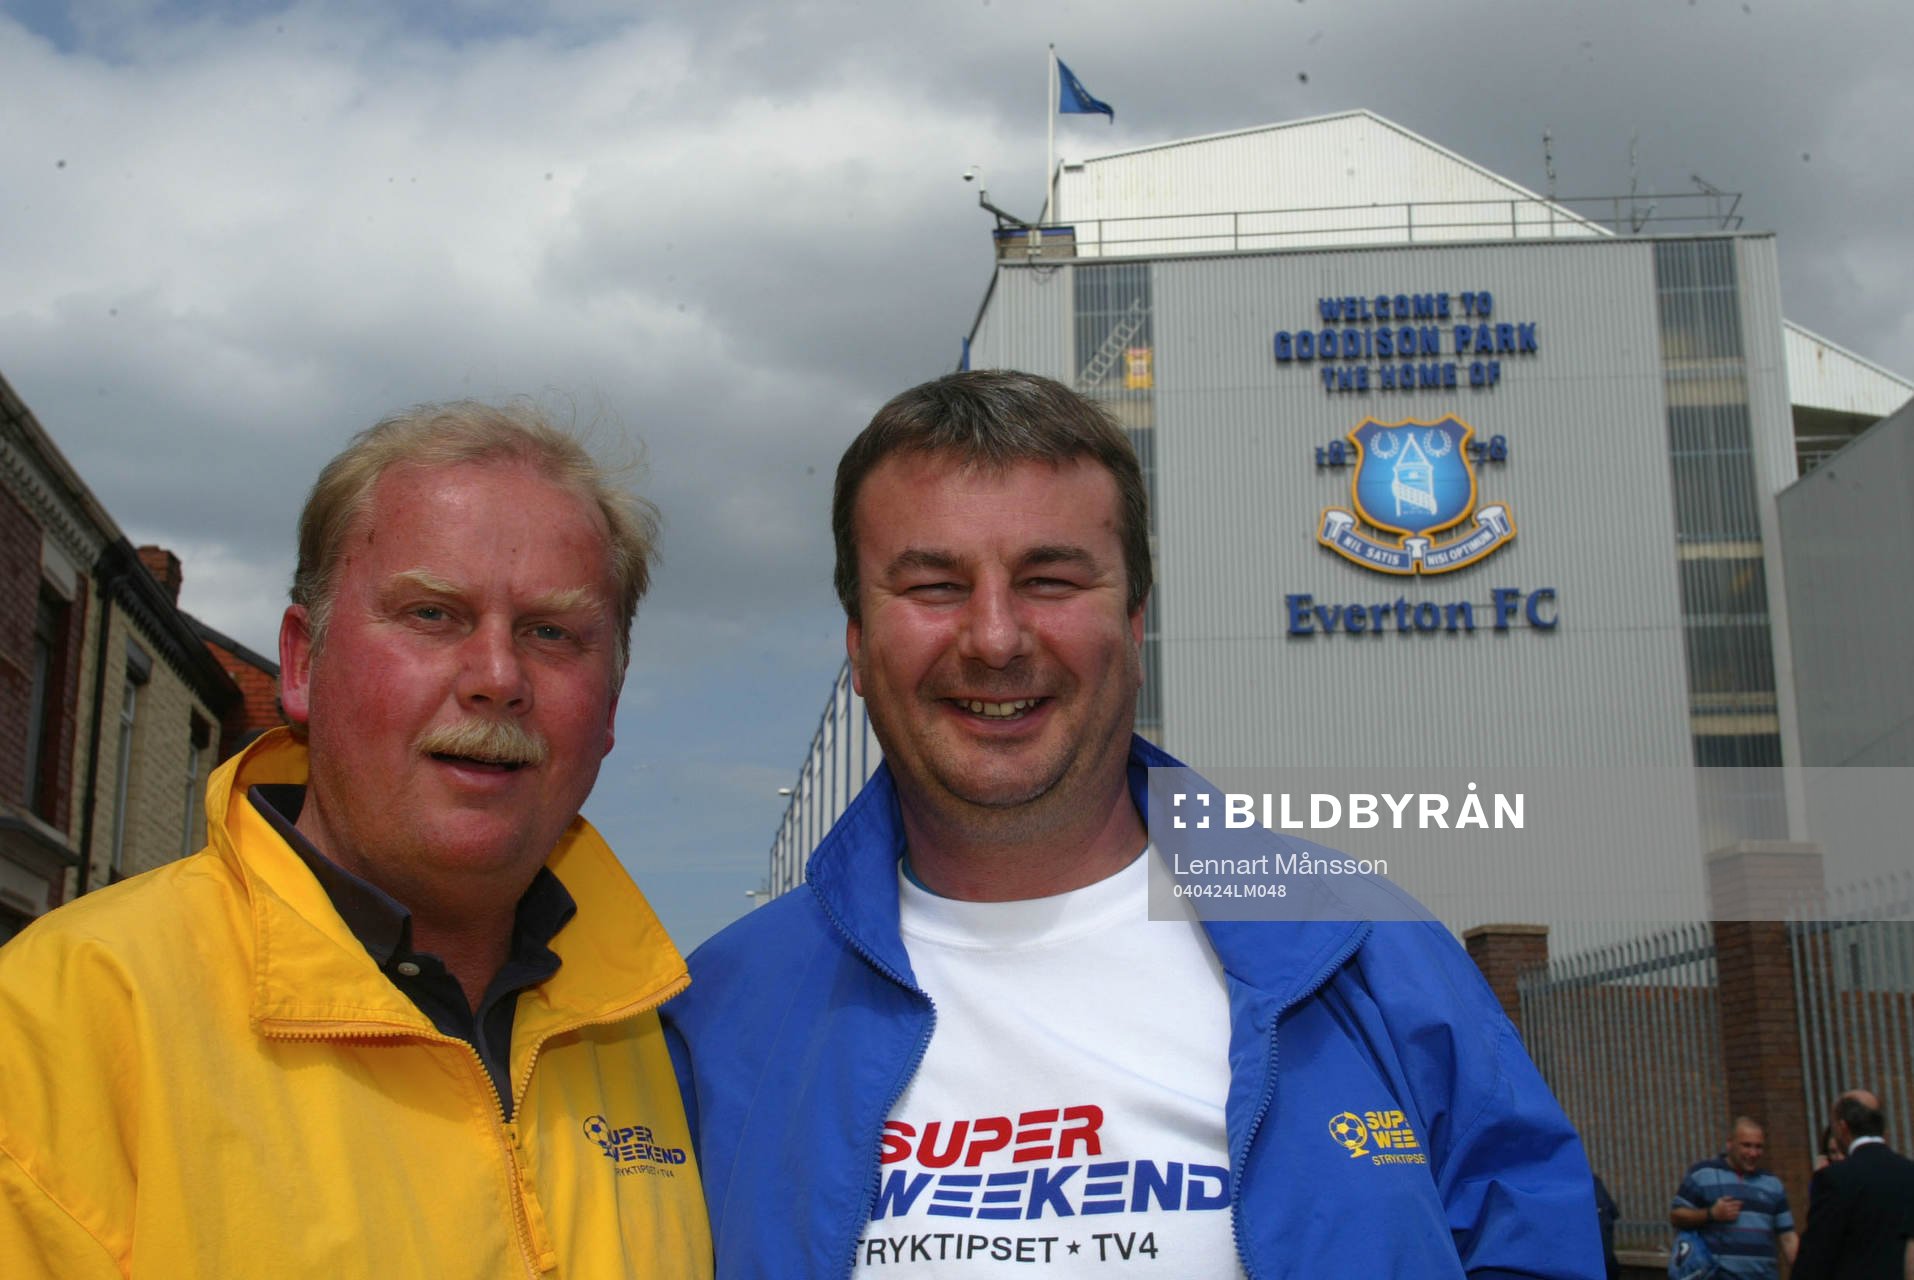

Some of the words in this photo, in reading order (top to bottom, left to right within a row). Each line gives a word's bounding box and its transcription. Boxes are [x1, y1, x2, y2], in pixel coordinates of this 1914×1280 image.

[1318, 292, 1450, 322] WELCOME
[1460, 290, 1493, 318] TO
[1274, 325, 1440, 362] GOODISON
[1453, 322, 1538, 354] PARK
[1321, 365, 1370, 392] THE
[1380, 362, 1457, 391] HOME
[1468, 360, 1500, 386] OF
[1343, 535, 1361, 554] NIL
[1366, 546, 1400, 566] SATIS
[1426, 551, 1449, 566] NISI
[1286, 593, 1473, 634] Everton
[1491, 587, 1558, 629] FC
[881, 1104, 1104, 1168] SUPER
[871, 1160, 1231, 1220] WEEKEND
[1092, 1232, 1159, 1262] TV4
